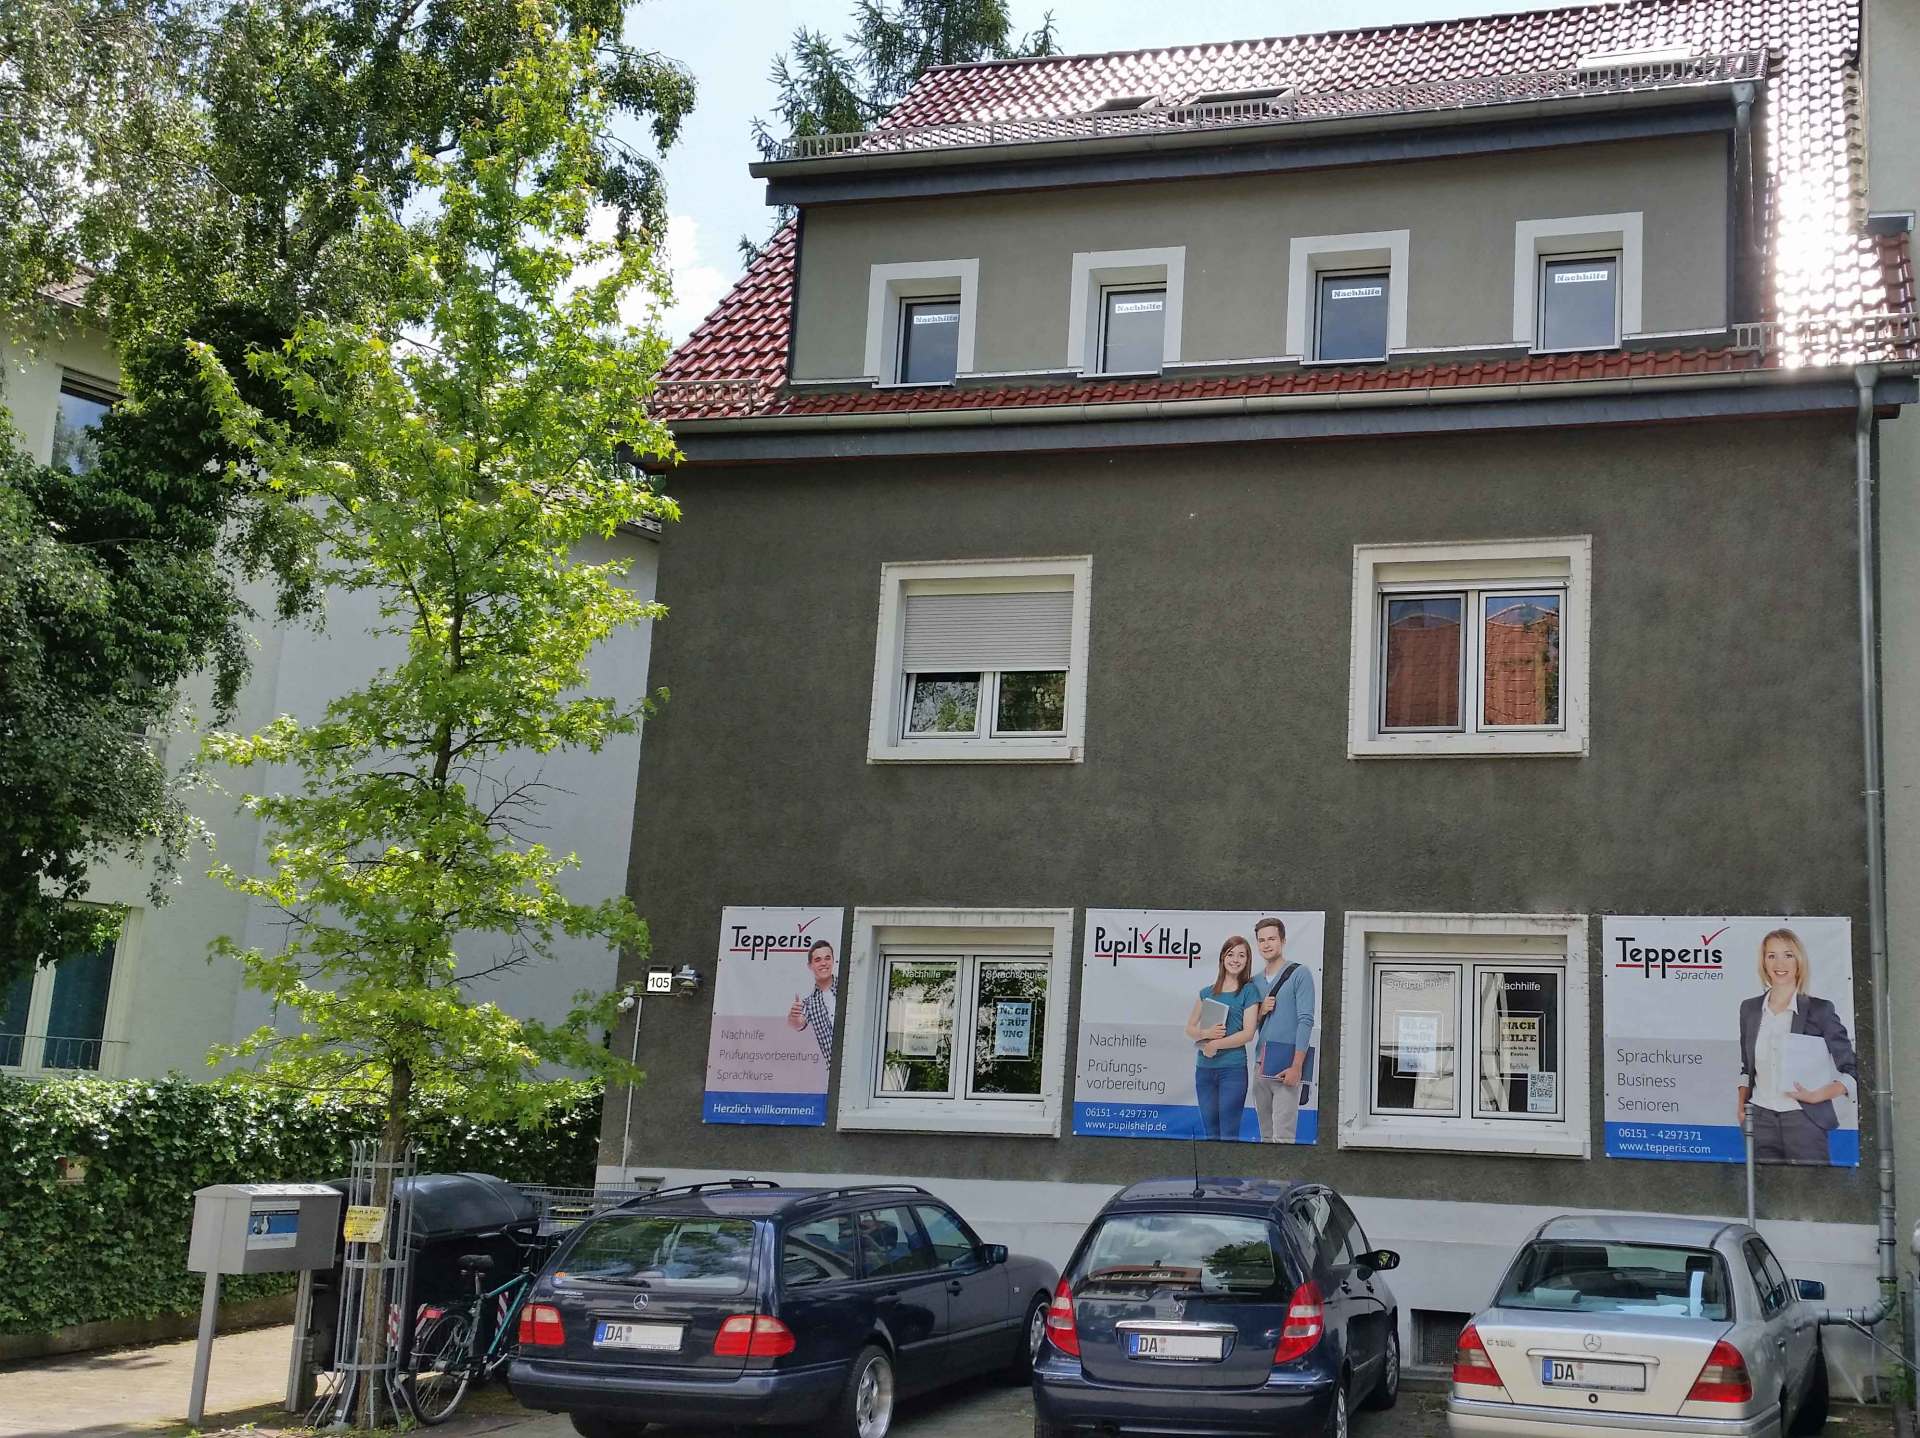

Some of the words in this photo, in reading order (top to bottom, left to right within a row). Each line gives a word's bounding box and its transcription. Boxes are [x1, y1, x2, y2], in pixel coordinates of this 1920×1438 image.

[1556, 271, 1607, 281] Nachhilfe
[1333, 288, 1381, 298] Nachhilfe
[1116, 302, 1162, 312] Nachhilfe
[914, 315, 958, 323] Nachhilfe
[731, 925, 812, 961] Tepperis
[1159, 928, 1201, 968] Help
[1615, 936, 1723, 979] Tepperis
[1674, 969, 1724, 982] Sprachen
[650, 977, 670, 988] 105
[1496, 981, 1541, 991] Nachhilfe
[721, 1029, 765, 1041] Nachhilfe
[1003, 1030, 1024, 1038] UNG
[1089, 1033, 1147, 1048] Nachhilfe
[719, 1049, 820, 1064] Prüfungsvorbereitung
[1616, 1048, 1703, 1066] Sprachkurse
[1087, 1059, 1148, 1076] Prüfungs-
[716, 1069, 774, 1082] Sprachkurse
[1617, 1072, 1676, 1088] Business
[1086, 1078, 1166, 1094] vorbereitung
[713, 1103, 751, 1114] Herzlich
[753, 1104, 815, 1116] willkommen!
[1617, 1096, 1679, 1113] Senioren
[1085, 1108, 1110, 1118] 06151
[1119, 1109, 1159, 1119] 4297370
[1085, 1120, 1167, 1132] www.pupilshelp.de
[1618, 1128, 1647, 1138] 06151
[1657, 1130, 1702, 1141] 4297371
[1619, 1143, 1711, 1154] www.tepperis.com
[605, 1326, 623, 1342] DA
[1139, 1337, 1158, 1353] DA
[1553, 1363, 1575, 1380] DA
